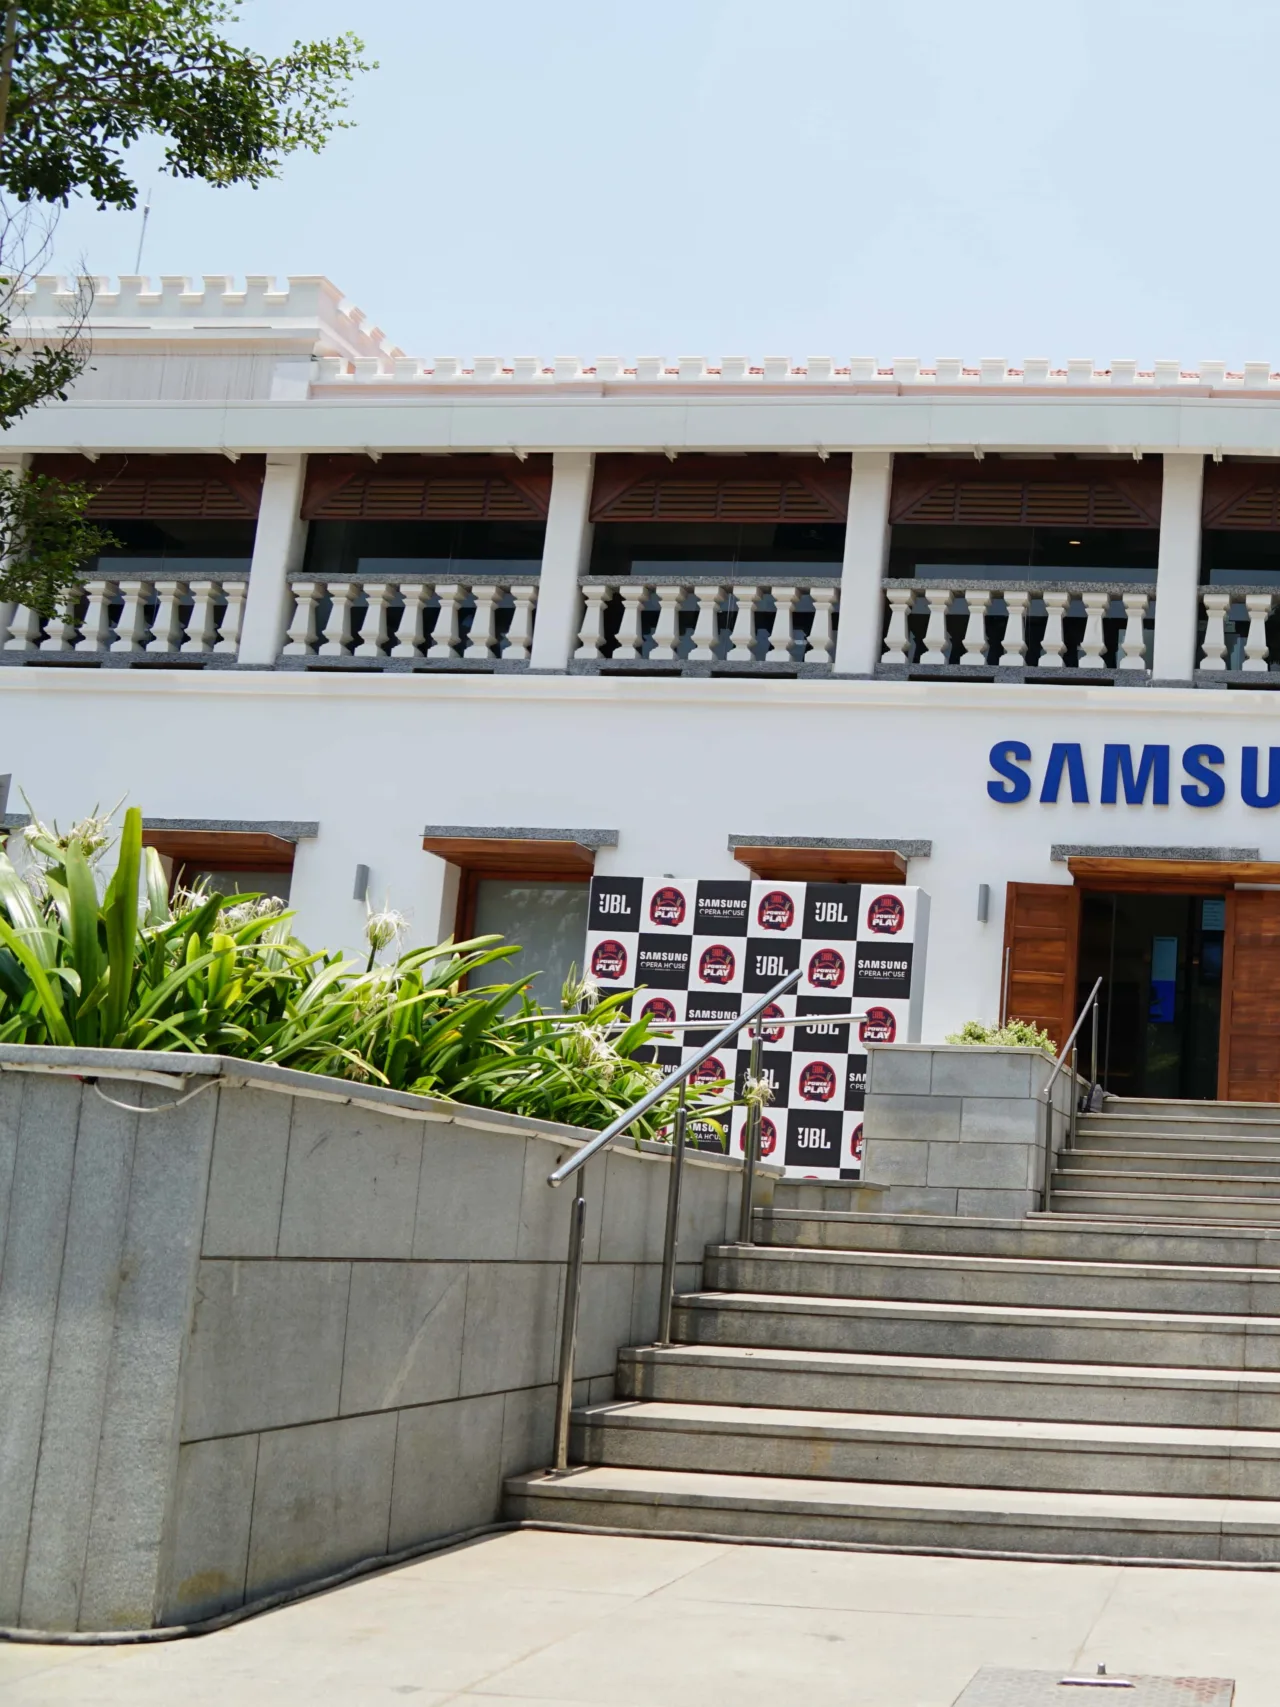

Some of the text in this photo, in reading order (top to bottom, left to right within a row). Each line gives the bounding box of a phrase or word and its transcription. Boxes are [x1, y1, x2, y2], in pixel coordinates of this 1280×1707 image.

[599, 893, 631, 914] JBL
[698, 898, 748, 909] SAMSUNG
[654, 910, 681, 918] PLAY
[815, 902, 848, 922] JBL
[762, 914, 789, 923] PLAY
[872, 918, 898, 926] PLAY
[639, 951, 689, 962] SAMSUNG
[596, 963, 622, 972] PLAY
[755, 955, 789, 976] JBL
[857, 959, 908, 970] SAMSUNG
[703, 968, 730, 977] PLAY
[813, 972, 839, 981] PLAY
[858, 969, 881, 977] OPERA
[883, 970, 906, 978] HOUSE
[688, 1009, 738, 1020] SAMSUNG
[863, 1031, 890, 1039] PLAY
[803, 1085, 830, 1094] PLAY
[797, 1127, 831, 1149] JBL
